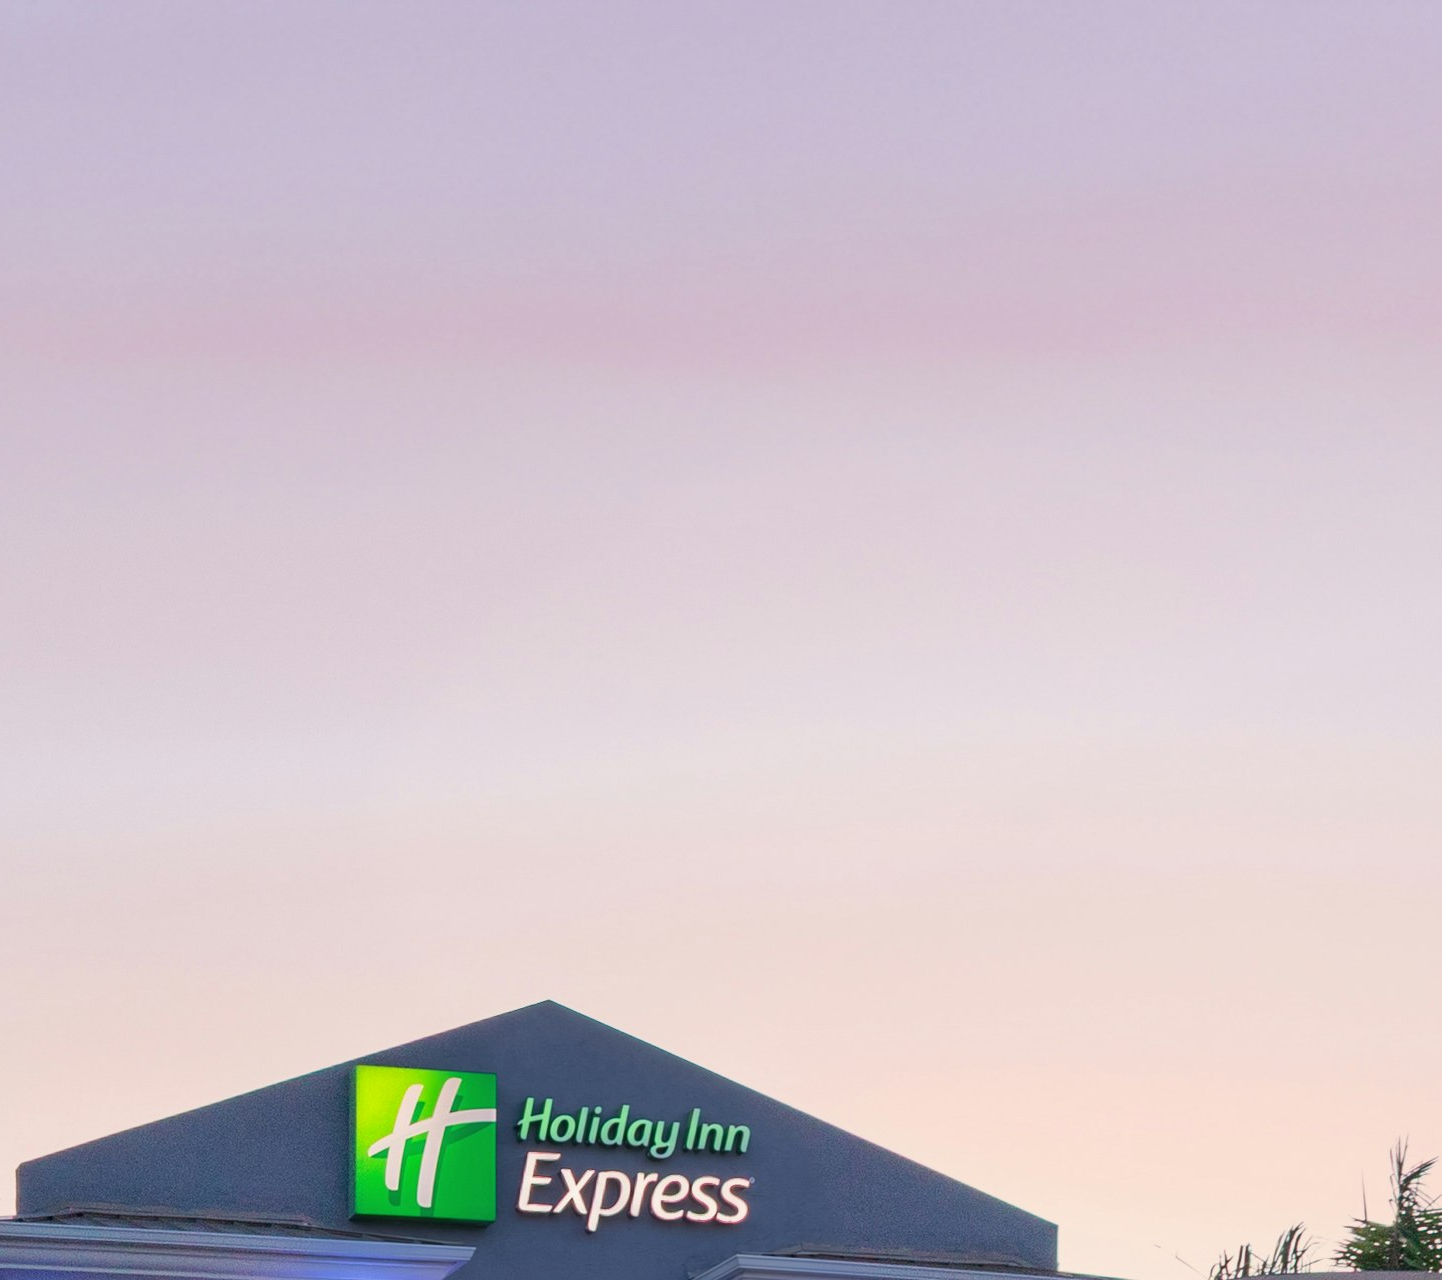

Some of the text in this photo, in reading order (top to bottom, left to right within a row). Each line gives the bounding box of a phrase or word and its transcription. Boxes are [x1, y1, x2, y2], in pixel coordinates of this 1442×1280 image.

[517, 1097, 750, 1157] Holiday Inn
[516, 1151, 751, 1232] Express
